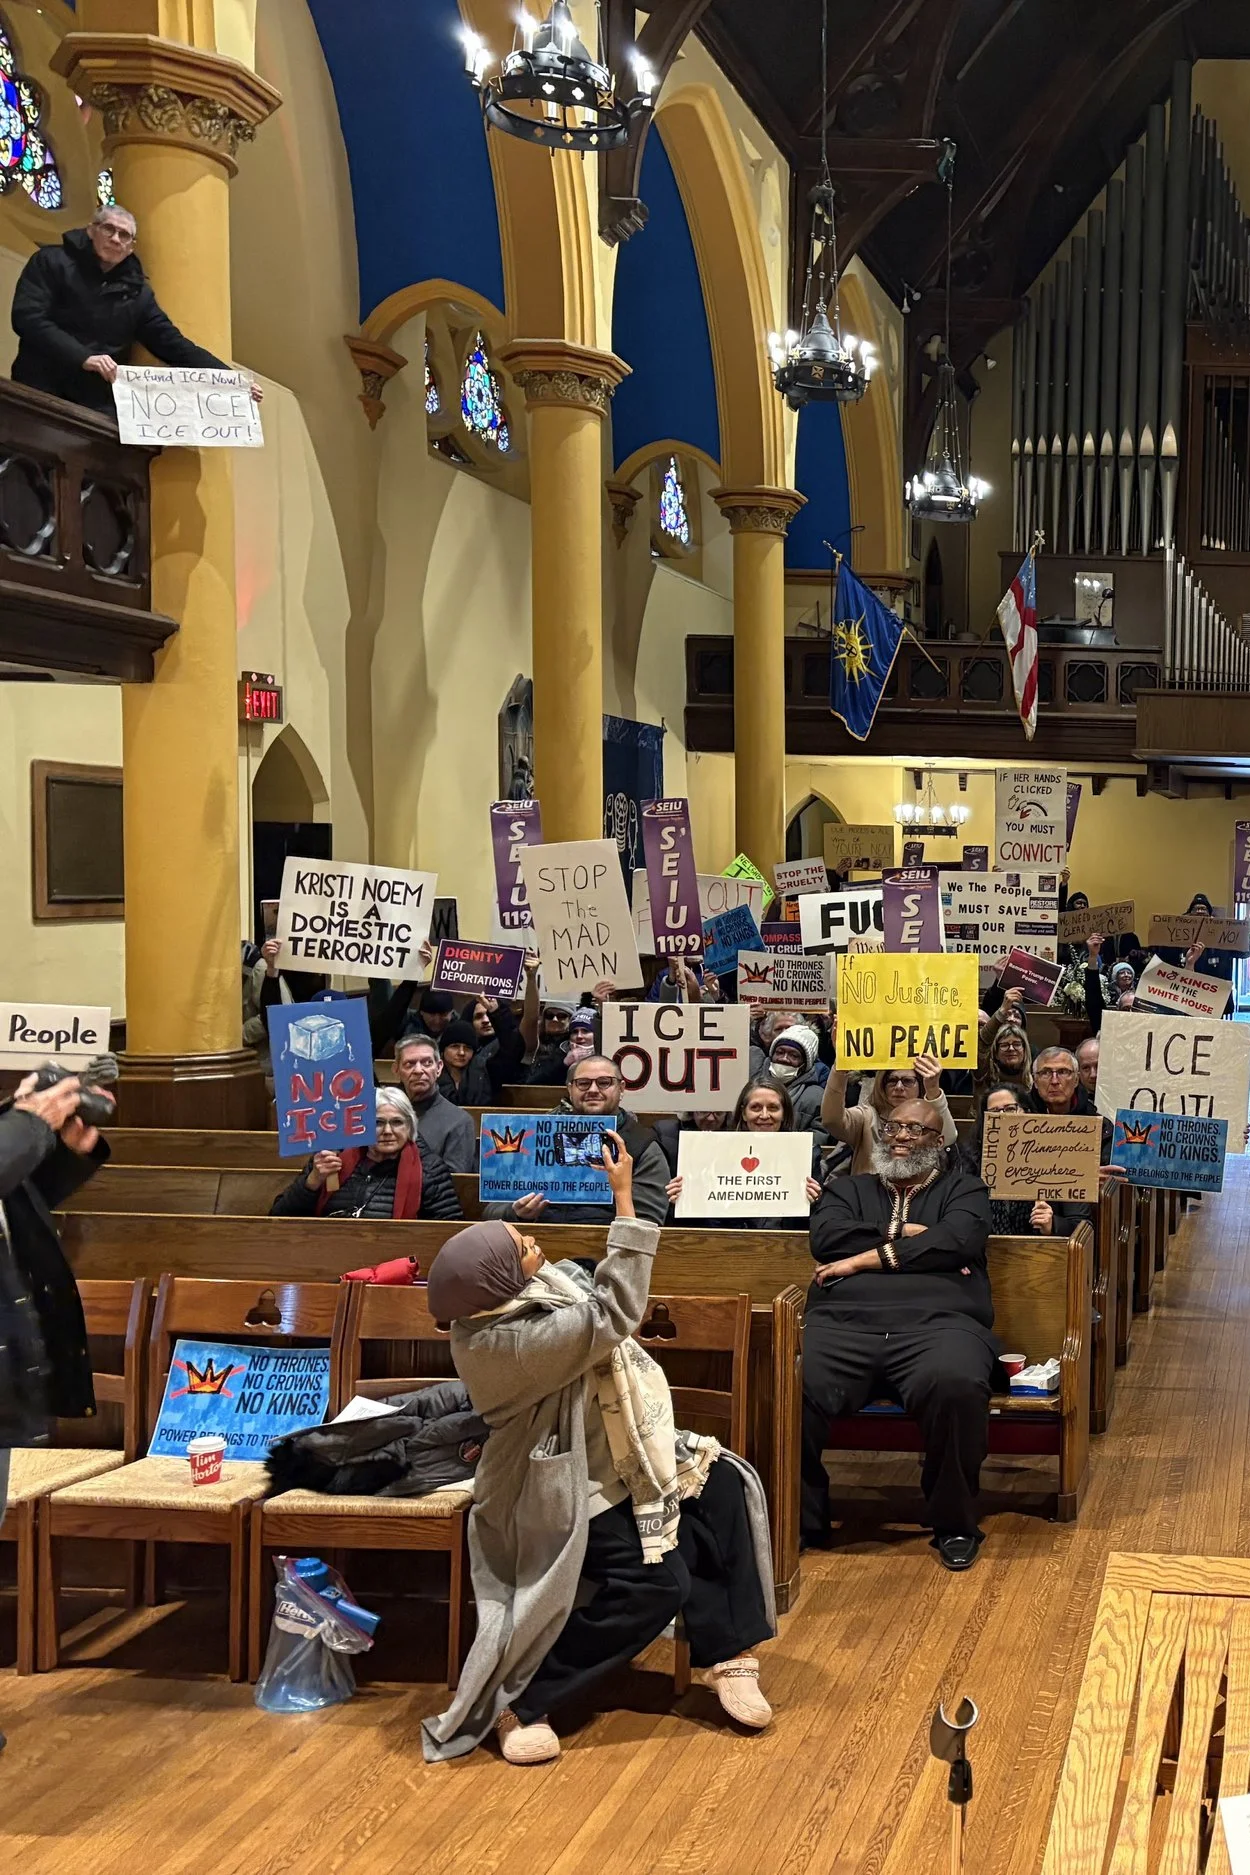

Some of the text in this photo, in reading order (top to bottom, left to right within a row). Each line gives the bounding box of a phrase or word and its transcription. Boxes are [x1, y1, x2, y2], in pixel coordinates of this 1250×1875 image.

[180, 371, 206, 383] ICE
[131, 385, 257, 425] NO ICE!
[136, 424, 253, 441] ICE OUT!
[253, 691, 277, 718] EXIT
[1000, 773, 1061, 783] IF HER HANDS
[1014, 786, 1052, 794] CLICKED
[656, 801, 682, 812] SEIU
[1006, 822, 1055, 835] YOU MUST
[1000, 842, 1064, 863] CONVICT
[538, 864, 607, 892] STOP
[659, 826, 688, 929] SEIU
[776, 866, 824, 880] STOP THE
[901, 870, 931, 879] SEIU
[295, 871, 423, 907] KRISTI NOEM
[708, 882, 762, 913] OUT
[947, 882, 963, 892] We
[969, 882, 987, 892] The
[995, 884, 1032, 897] People
[330, 901, 381, 920] IS A
[959, 904, 1027, 916] MUST SAVE
[291, 912, 412, 943] DOMESTIC
[552, 922, 611, 951] MAD
[982, 922, 1005, 932] OUR
[1167, 927, 1239, 944] YES! NO!
[288, 937, 410, 968] TERRORIST
[657, 934, 700, 953] 1199
[445, 947, 504, 964] DIGNITY
[841, 955, 854, 971] If
[442, 960, 465, 972] NOT
[558, 952, 619, 980] MAN
[441, 970, 514, 989] DEPORTATIONS.
[773, 979, 826, 992] NO KINGS.
[1180, 976, 1218, 993] KINGS
[841, 971, 963, 1008] NO Justice,
[1170, 983, 1198, 997] IN THE
[1148, 986, 1214, 1014] WHITE HOUSE
[9, 1014, 98, 1052] People
[619, 1005, 725, 1043] ICE
[845, 1024, 969, 1058] NO PEACE
[1145, 1030, 1214, 1076] ICE
[612, 1044, 737, 1093] OUT
[290, 1070, 367, 1104] NO
[286, 1104, 368, 1144] ICE
[1009, 1119, 1096, 1138] of Columbus
[987, 1116, 1000, 1158] ICE
[749, 1145, 752, 1155] I
[1006, 1140, 1019, 1162] of
[1158, 1144, 1221, 1163] NO KINGS.
[717, 1175, 782, 1186] THE FIRST
[1005, 1164, 1084, 1184] everywhere
[483, 1180, 609, 1192] POWER BELONGS TO THE PEOPLE
[1037, 1189, 1086, 1200] FUCK ICE
[708, 1191, 789, 1201] AMENDMENT
[248, 1355, 330, 1373] NO THRONES.
[235, 1393, 320, 1416] NO KINGS.
[193, 1454, 216, 1468] Tim
